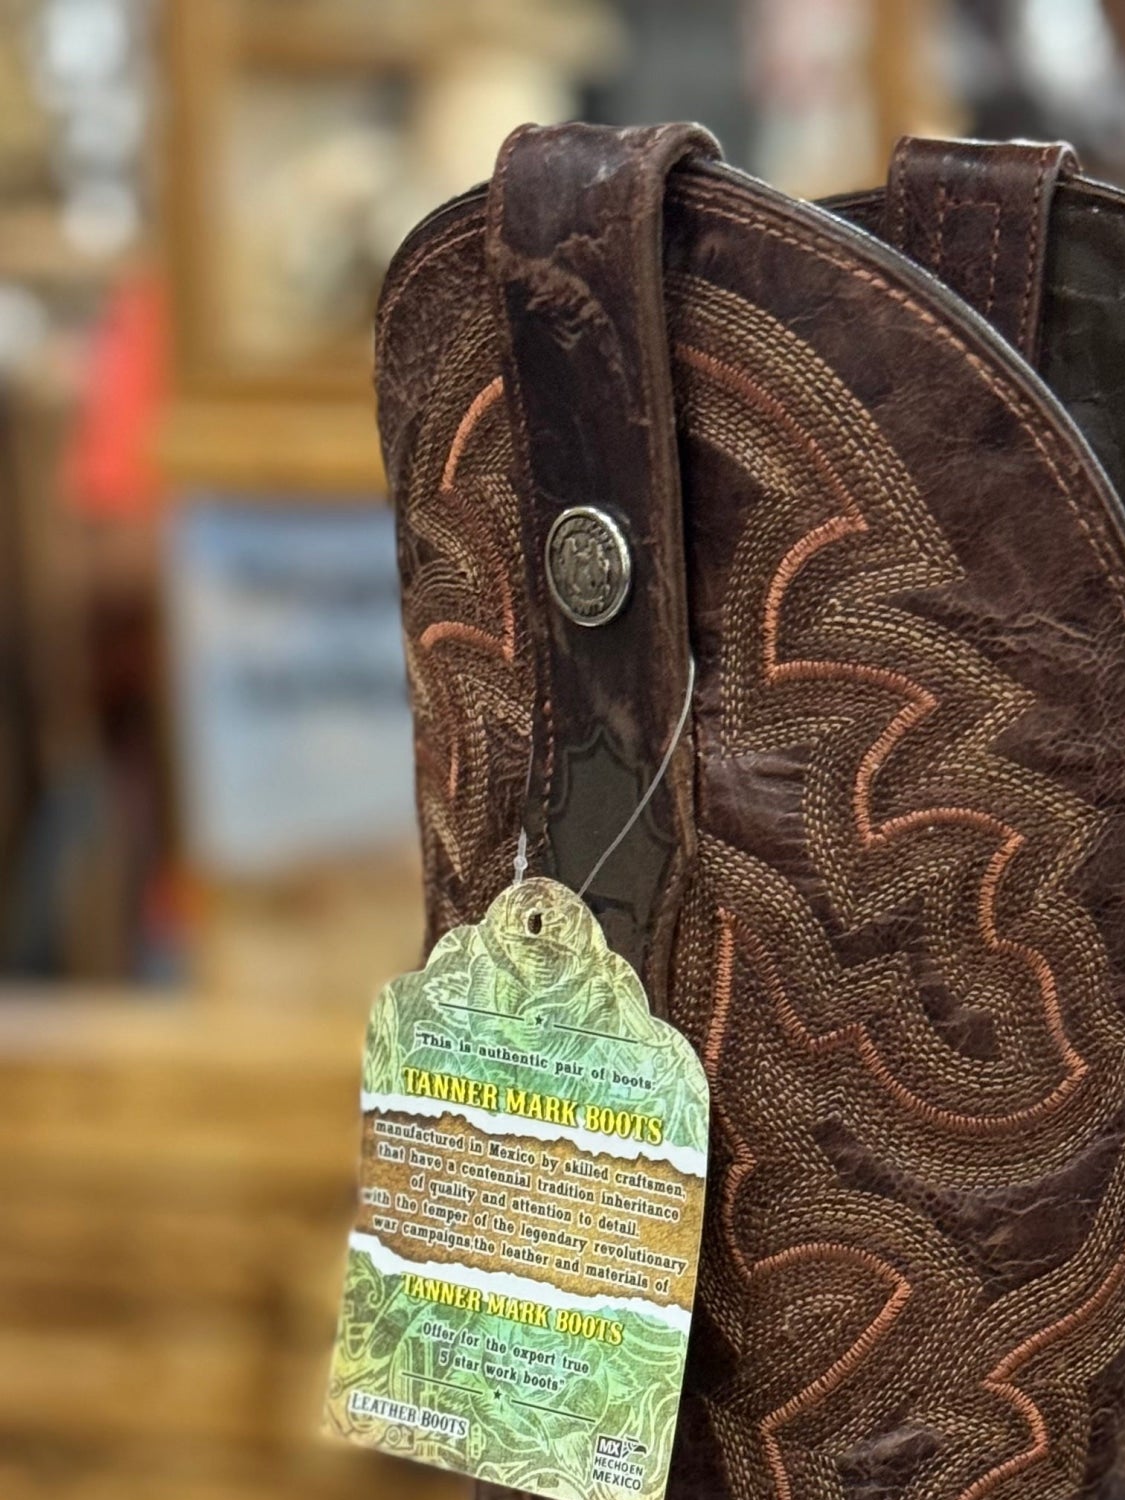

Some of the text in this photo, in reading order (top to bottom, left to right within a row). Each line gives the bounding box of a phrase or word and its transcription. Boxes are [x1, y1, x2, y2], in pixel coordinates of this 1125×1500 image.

[459, 1040, 471, 1053] is
[479, 1045, 548, 1068] authentic
[555, 1061, 584, 1075] pair
[591, 1068, 605, 1080] of
[403, 1067, 663, 1147] TANNER MARK BOOTS
[376, 1121, 464, 1149] manufactured
[470, 1138, 482, 1153] in
[489, 1143, 535, 1165] Mexico
[542, 1154, 558, 1171] by
[565, 1160, 609, 1181] skilled
[379, 1144, 680, 1220] that have a centennial tradition inheritance
[411, 1175, 639, 1237] of quality and attention to detail.
[373, 1218, 397, 1231] war
[502, 1242, 548, 1265] leather
[555, 1259, 579, 1273] and
[586, 1265, 648, 1289] materials
[655, 1280, 669, 1293] of
[397, 1195, 417, 1211] the
[423, 1203, 468, 1224] temper
[475, 1214, 487, 1227] of
[493, 1218, 515, 1233] the
[521, 1224, 588, 1253] legendary
[594, 1242, 686, 1275] revolutionary
[401, 1272, 625, 1347] TANNER MARK BOOTS
[423, 1322, 589, 1374] Offer for the expert true
[439, 1351, 448, 1364] 5
[454, 1355, 479, 1371] star
[486, 1365, 517, 1381] work
[351, 1392, 467, 1436] LEATHER BOOTS
[598, 1438, 621, 1456] MX
[593, 1469, 641, 1490] MEXICO
